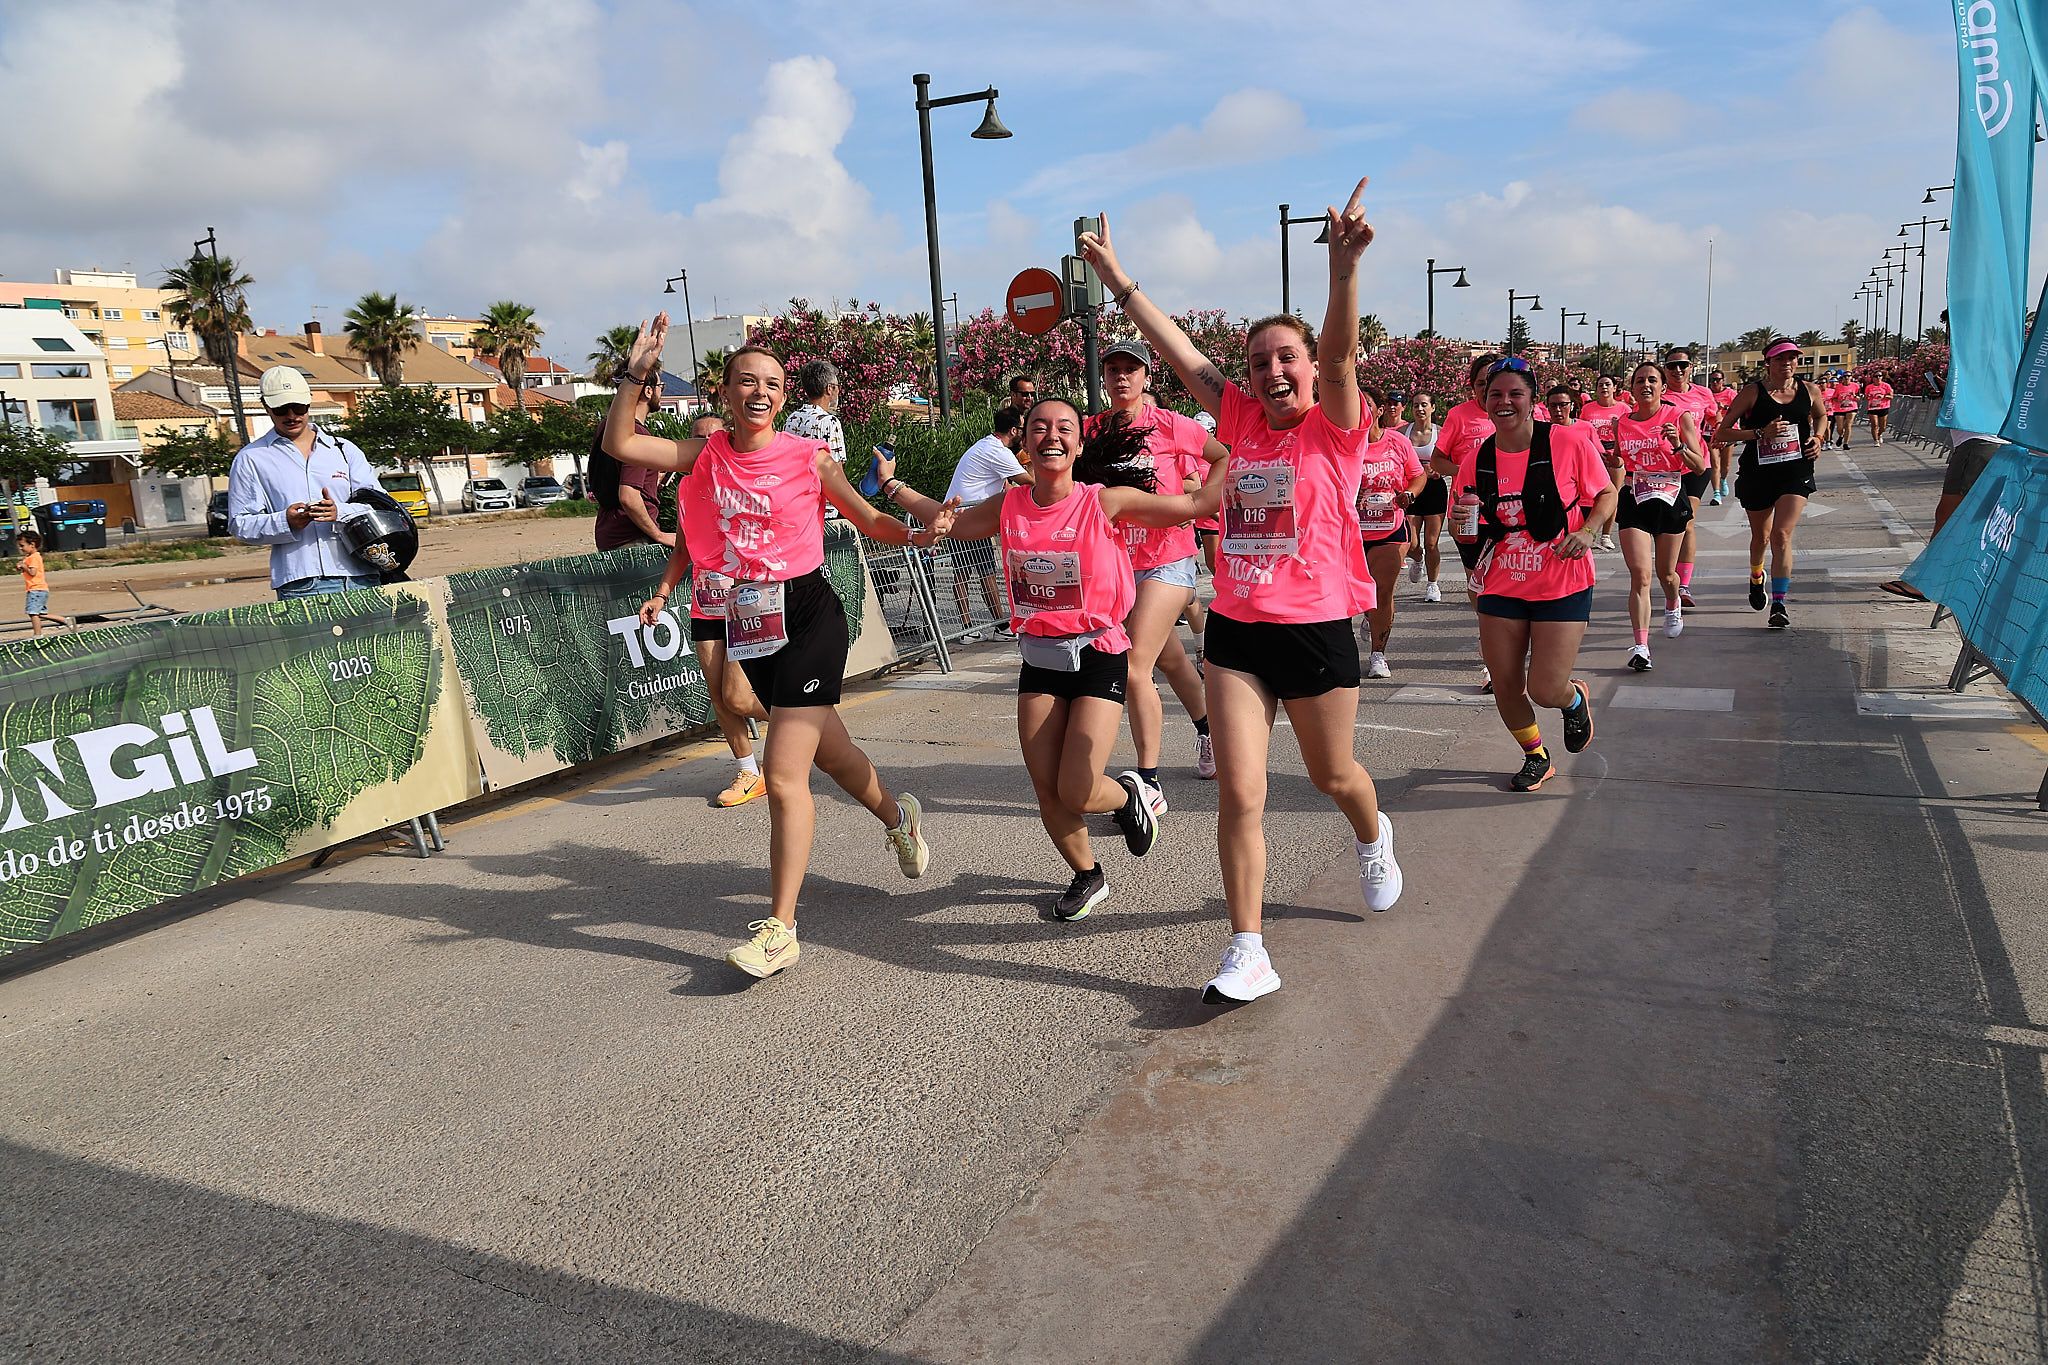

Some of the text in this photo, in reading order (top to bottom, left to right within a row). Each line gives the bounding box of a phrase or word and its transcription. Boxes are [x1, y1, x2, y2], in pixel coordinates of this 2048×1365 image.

[1362, 461, 1394, 475] ARRERA
[714, 487, 772, 517] ARRERA
[1244, 508, 1266, 522] 016
[1499, 554, 1543, 572] MUJER
[1511, 571, 1526, 582] 2026
[1030, 584, 1056, 598] 016
[499, 614, 532, 637] 1975
[742, 616, 762, 631] 016
[327, 655, 373, 683] 2026
[628, 667, 699, 700] Cuidando
[47, 835, 87, 868] de
[92, 823, 118, 854] ti
[123, 801, 208, 846] desde
[214, 785, 272, 821] 1975
